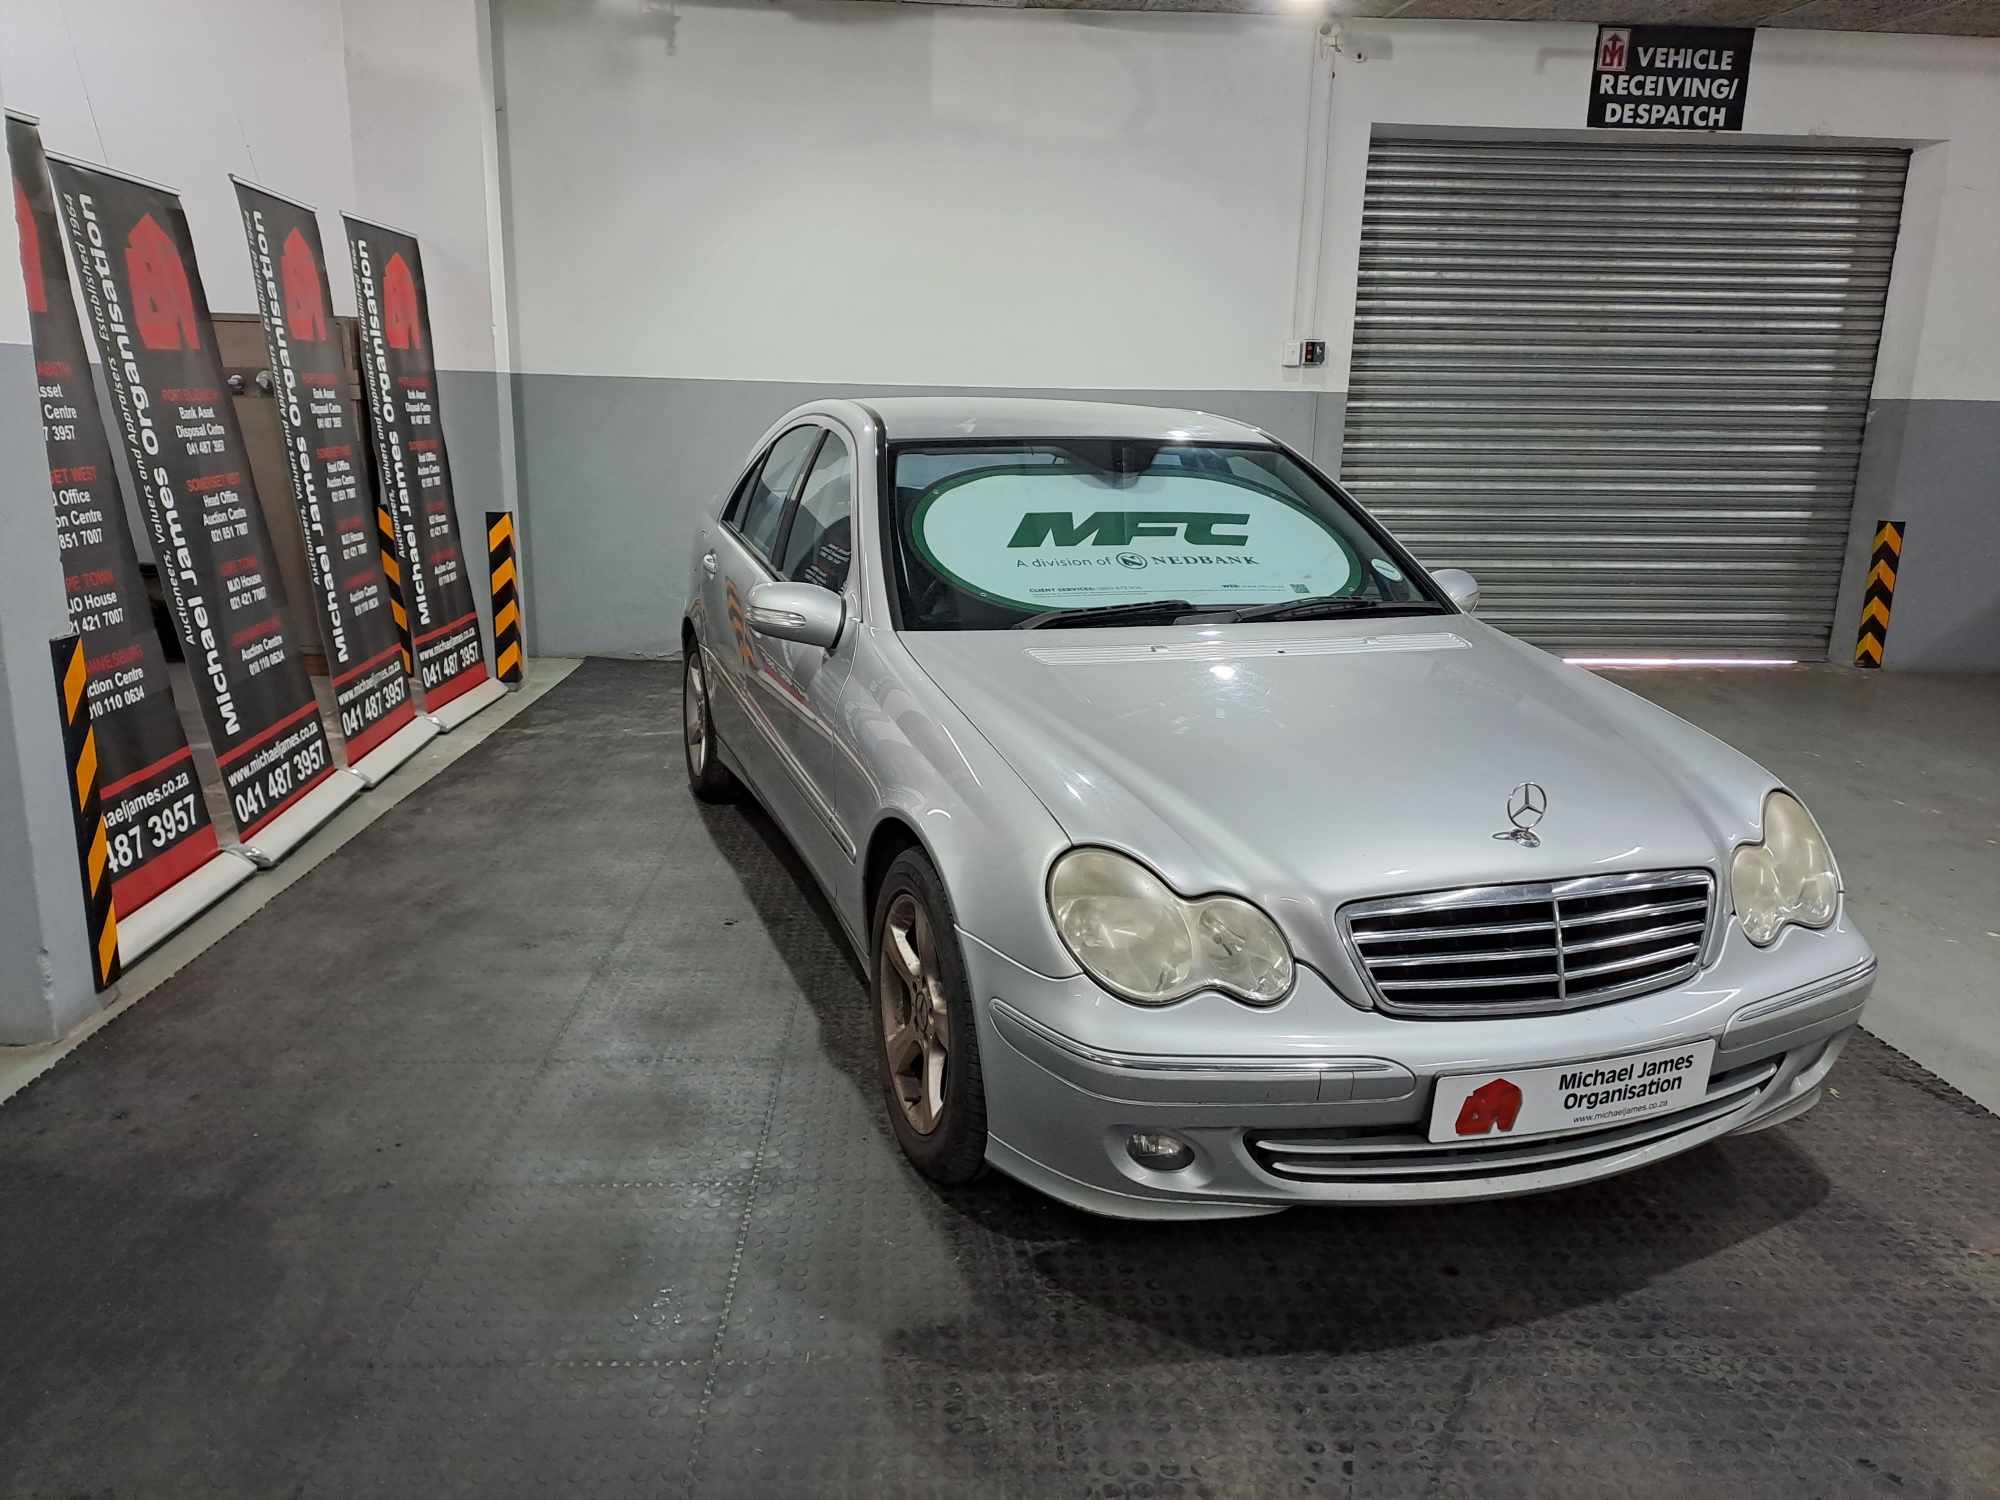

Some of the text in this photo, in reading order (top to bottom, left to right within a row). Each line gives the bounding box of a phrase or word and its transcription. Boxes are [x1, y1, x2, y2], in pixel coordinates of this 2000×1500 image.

[1636, 46, 1735, 71] VEHICLE
[1599, 73, 1740, 100] RECEIVING/
[1604, 102, 1727, 127] DESPATCH
[77, 193, 160, 456] Organisation
[252, 210, 302, 427] Organisation
[39, 384, 64, 398] sset
[44, 404, 77, 419] Centre
[63, 193, 196, 645] Auctioneers, Valuers and Appraisers Established 1964
[374, 417, 385, 440] and
[52, 425, 76, 441] 3957
[281, 420, 293, 447] and
[357, 240, 431, 625] Michael James Organisation
[287, 450, 303, 500] Valuers
[295, 436, 324, 537] James
[60, 489, 92, 505] Office
[70, 509, 103, 525] Centre
[153, 466, 198, 586] James
[1007, 511, 1251, 548] MFC
[59, 528, 103, 550] 851 7007
[1016, 554, 1260, 569] A division of NEDBANK
[68, 591, 117, 614] JO House
[82, 615, 101, 632] 421
[102, 608, 124, 627] 7007
[317, 545, 350, 664] Michael
[87, 666, 144, 698] ction Centre
[187, 595, 241, 736] Michael
[422, 640, 480, 688] 041 487 3957
[104, 694, 123, 713] 110
[124, 685, 145, 706] 0634
[342, 675, 406, 737] 041 487 3957
[234, 739, 326, 823] 041 487 3957
[104, 771, 190, 829] aeljames.co.za
[148, 793, 198, 848] 3957
[1558, 1053, 1694, 1091] Michael James
[1563, 1074, 1682, 1110] Organisation
